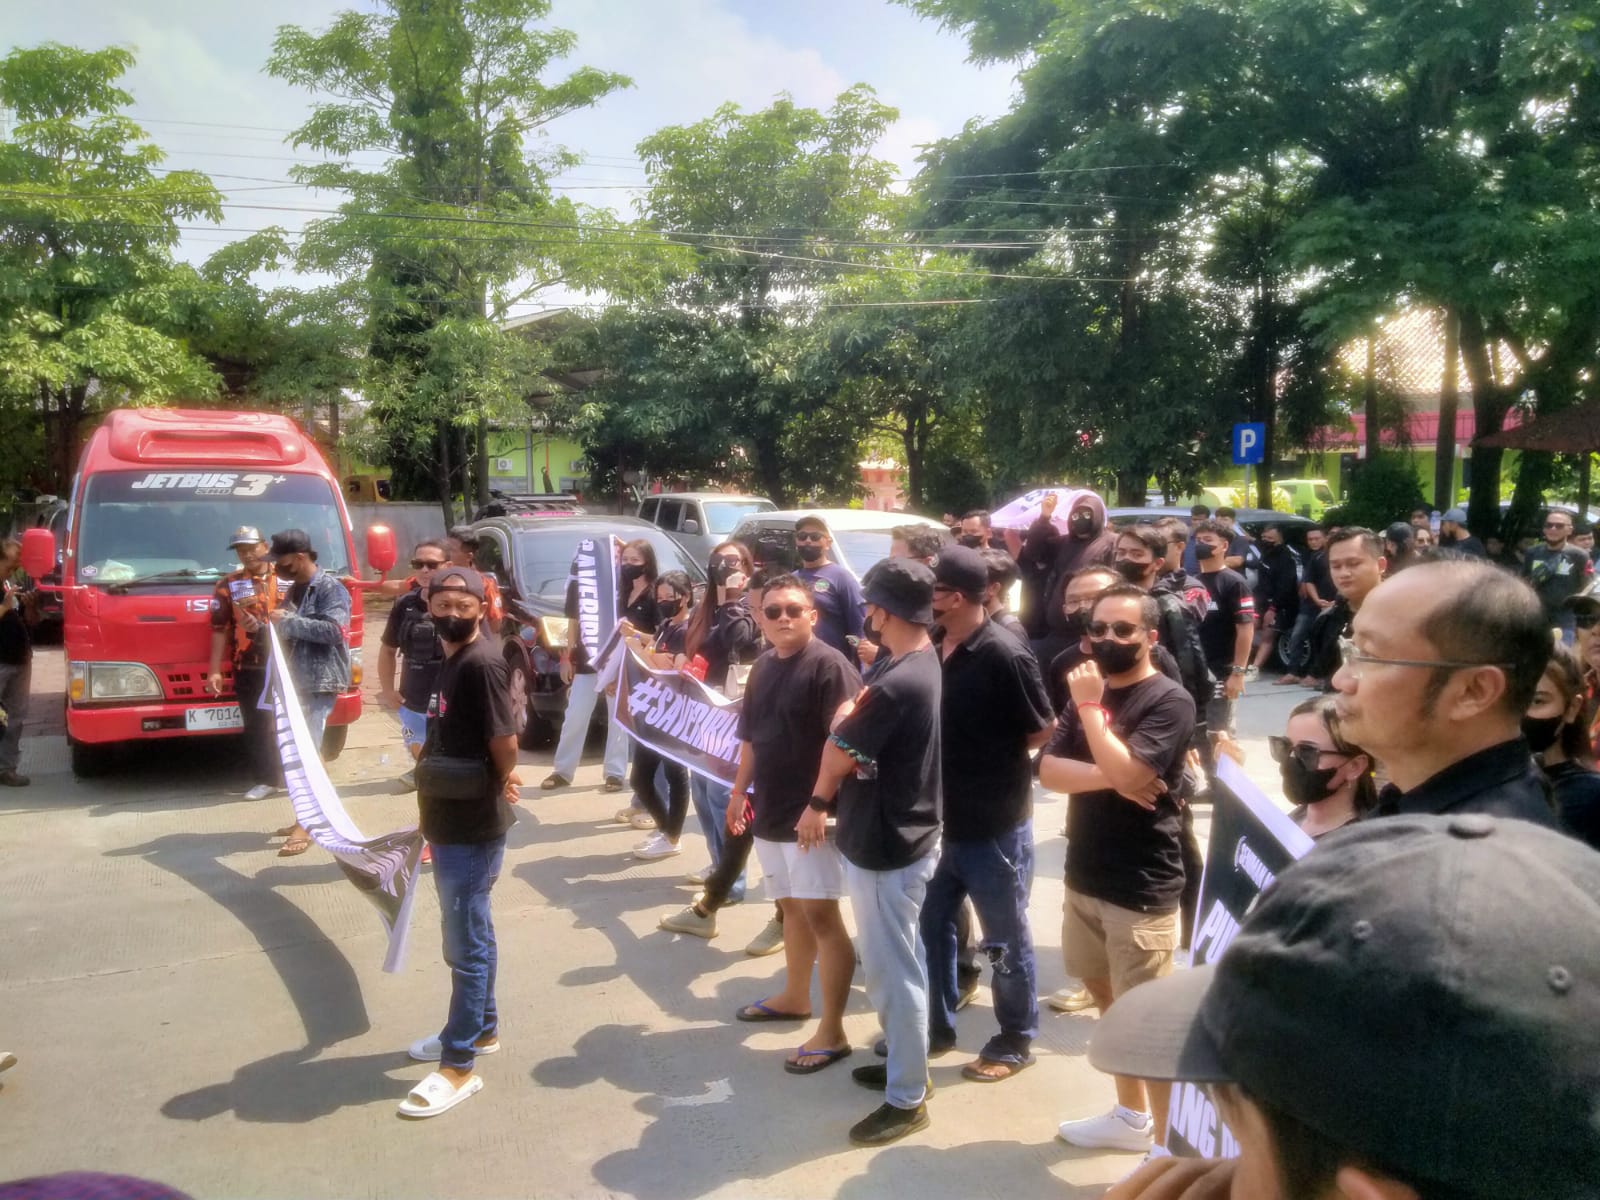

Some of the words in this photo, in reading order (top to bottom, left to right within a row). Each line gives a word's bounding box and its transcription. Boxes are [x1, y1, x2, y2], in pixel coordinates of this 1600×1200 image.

[1240, 429, 1256, 457] P
[131, 473, 239, 488] JETBUS
[186, 599, 215, 612] IS
[188, 709, 197, 723] K
